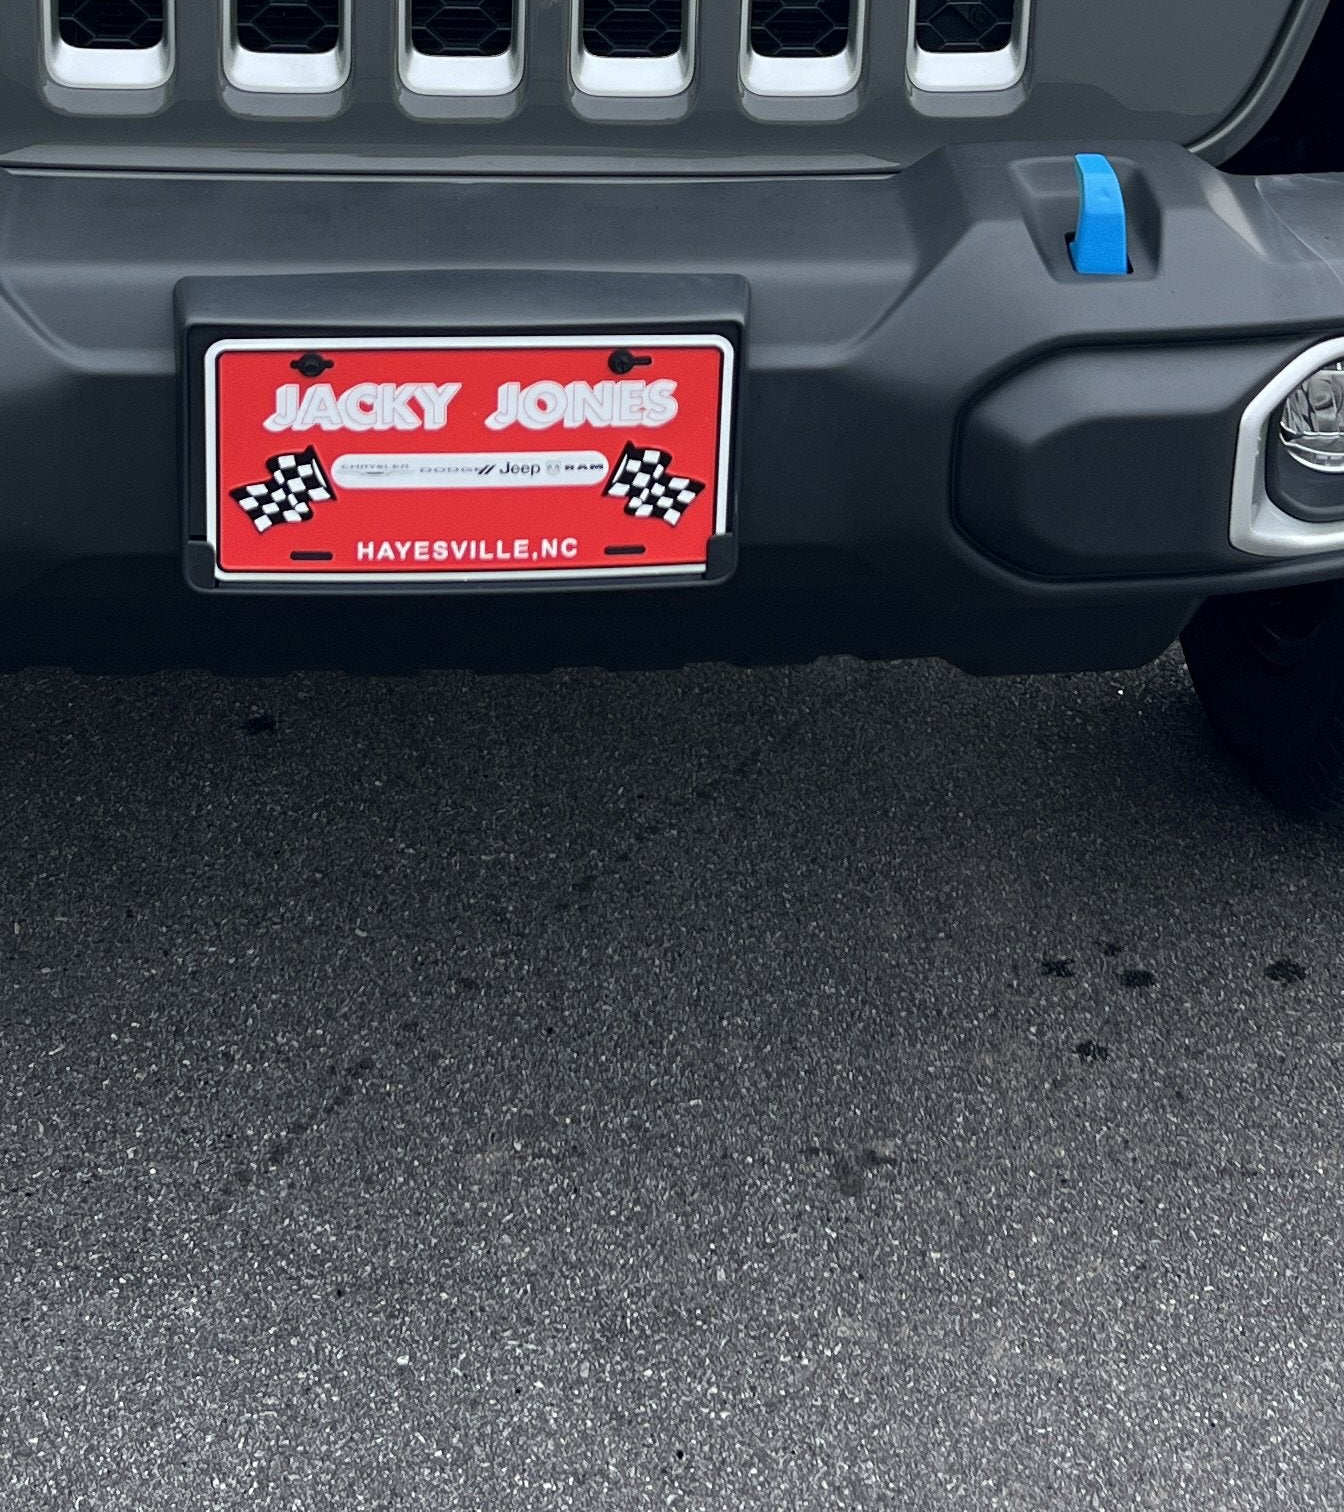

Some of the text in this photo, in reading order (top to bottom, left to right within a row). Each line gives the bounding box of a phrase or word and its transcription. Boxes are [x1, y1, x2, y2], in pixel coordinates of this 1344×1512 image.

[262, 378, 679, 433] JACKY JONES
[499, 461, 541, 476] Jeep
[356, 537, 578, 562] HAYESVILLE,NC
